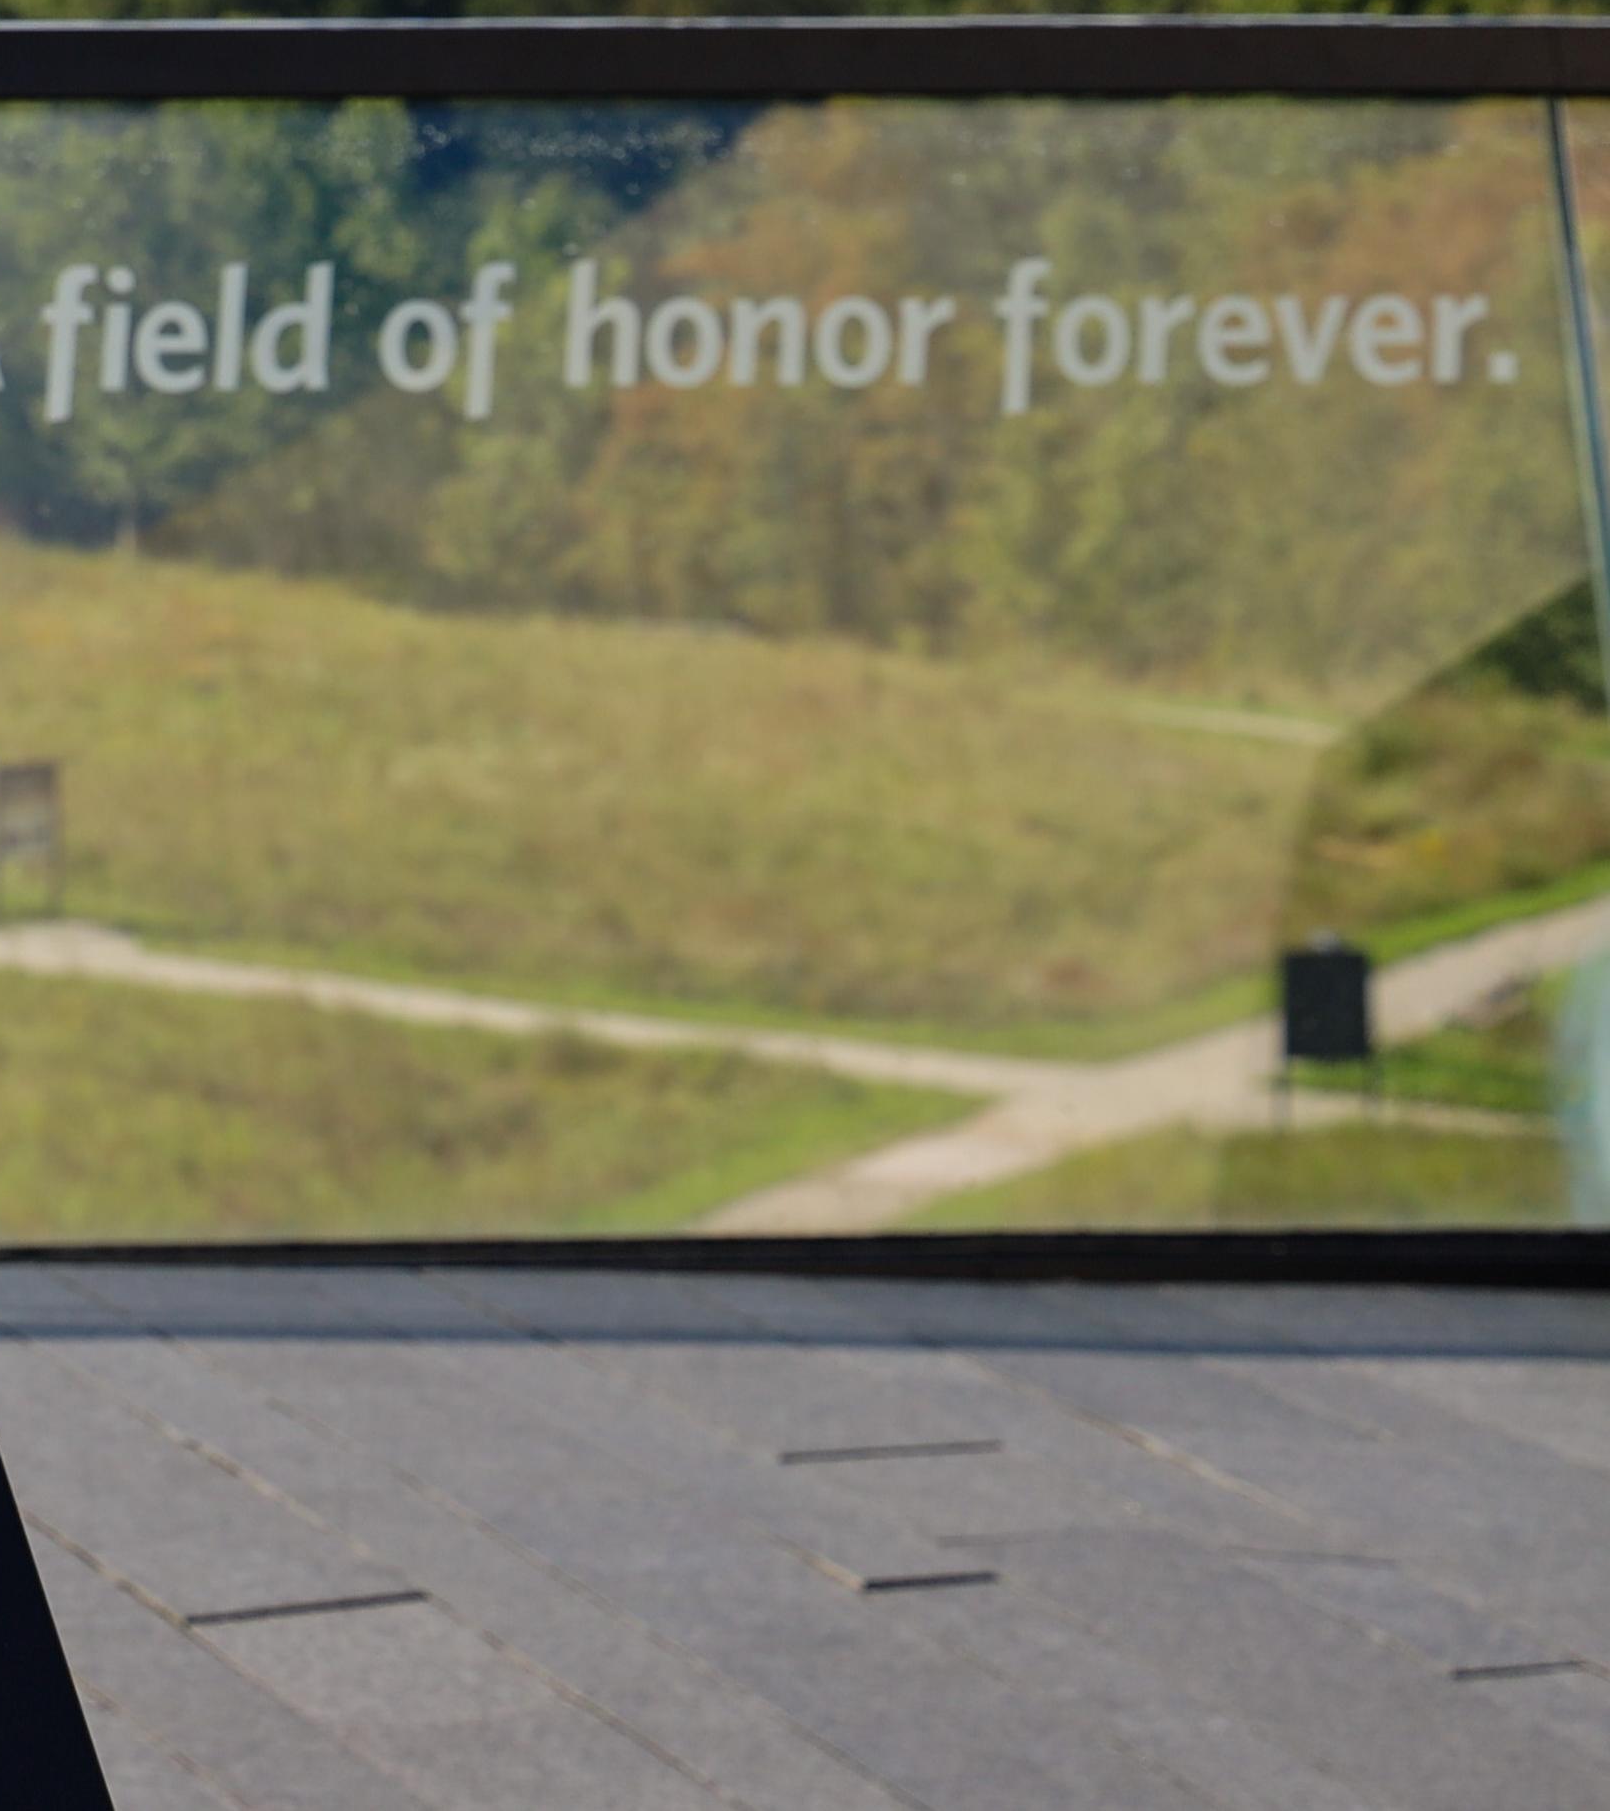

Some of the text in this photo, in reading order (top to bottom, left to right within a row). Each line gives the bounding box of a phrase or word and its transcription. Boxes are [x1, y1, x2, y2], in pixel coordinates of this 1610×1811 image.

[43, 261, 331, 420] field
[381, 264, 515, 419] of
[565, 256, 956, 389] honor
[999, 259, 1520, 415] forever.
